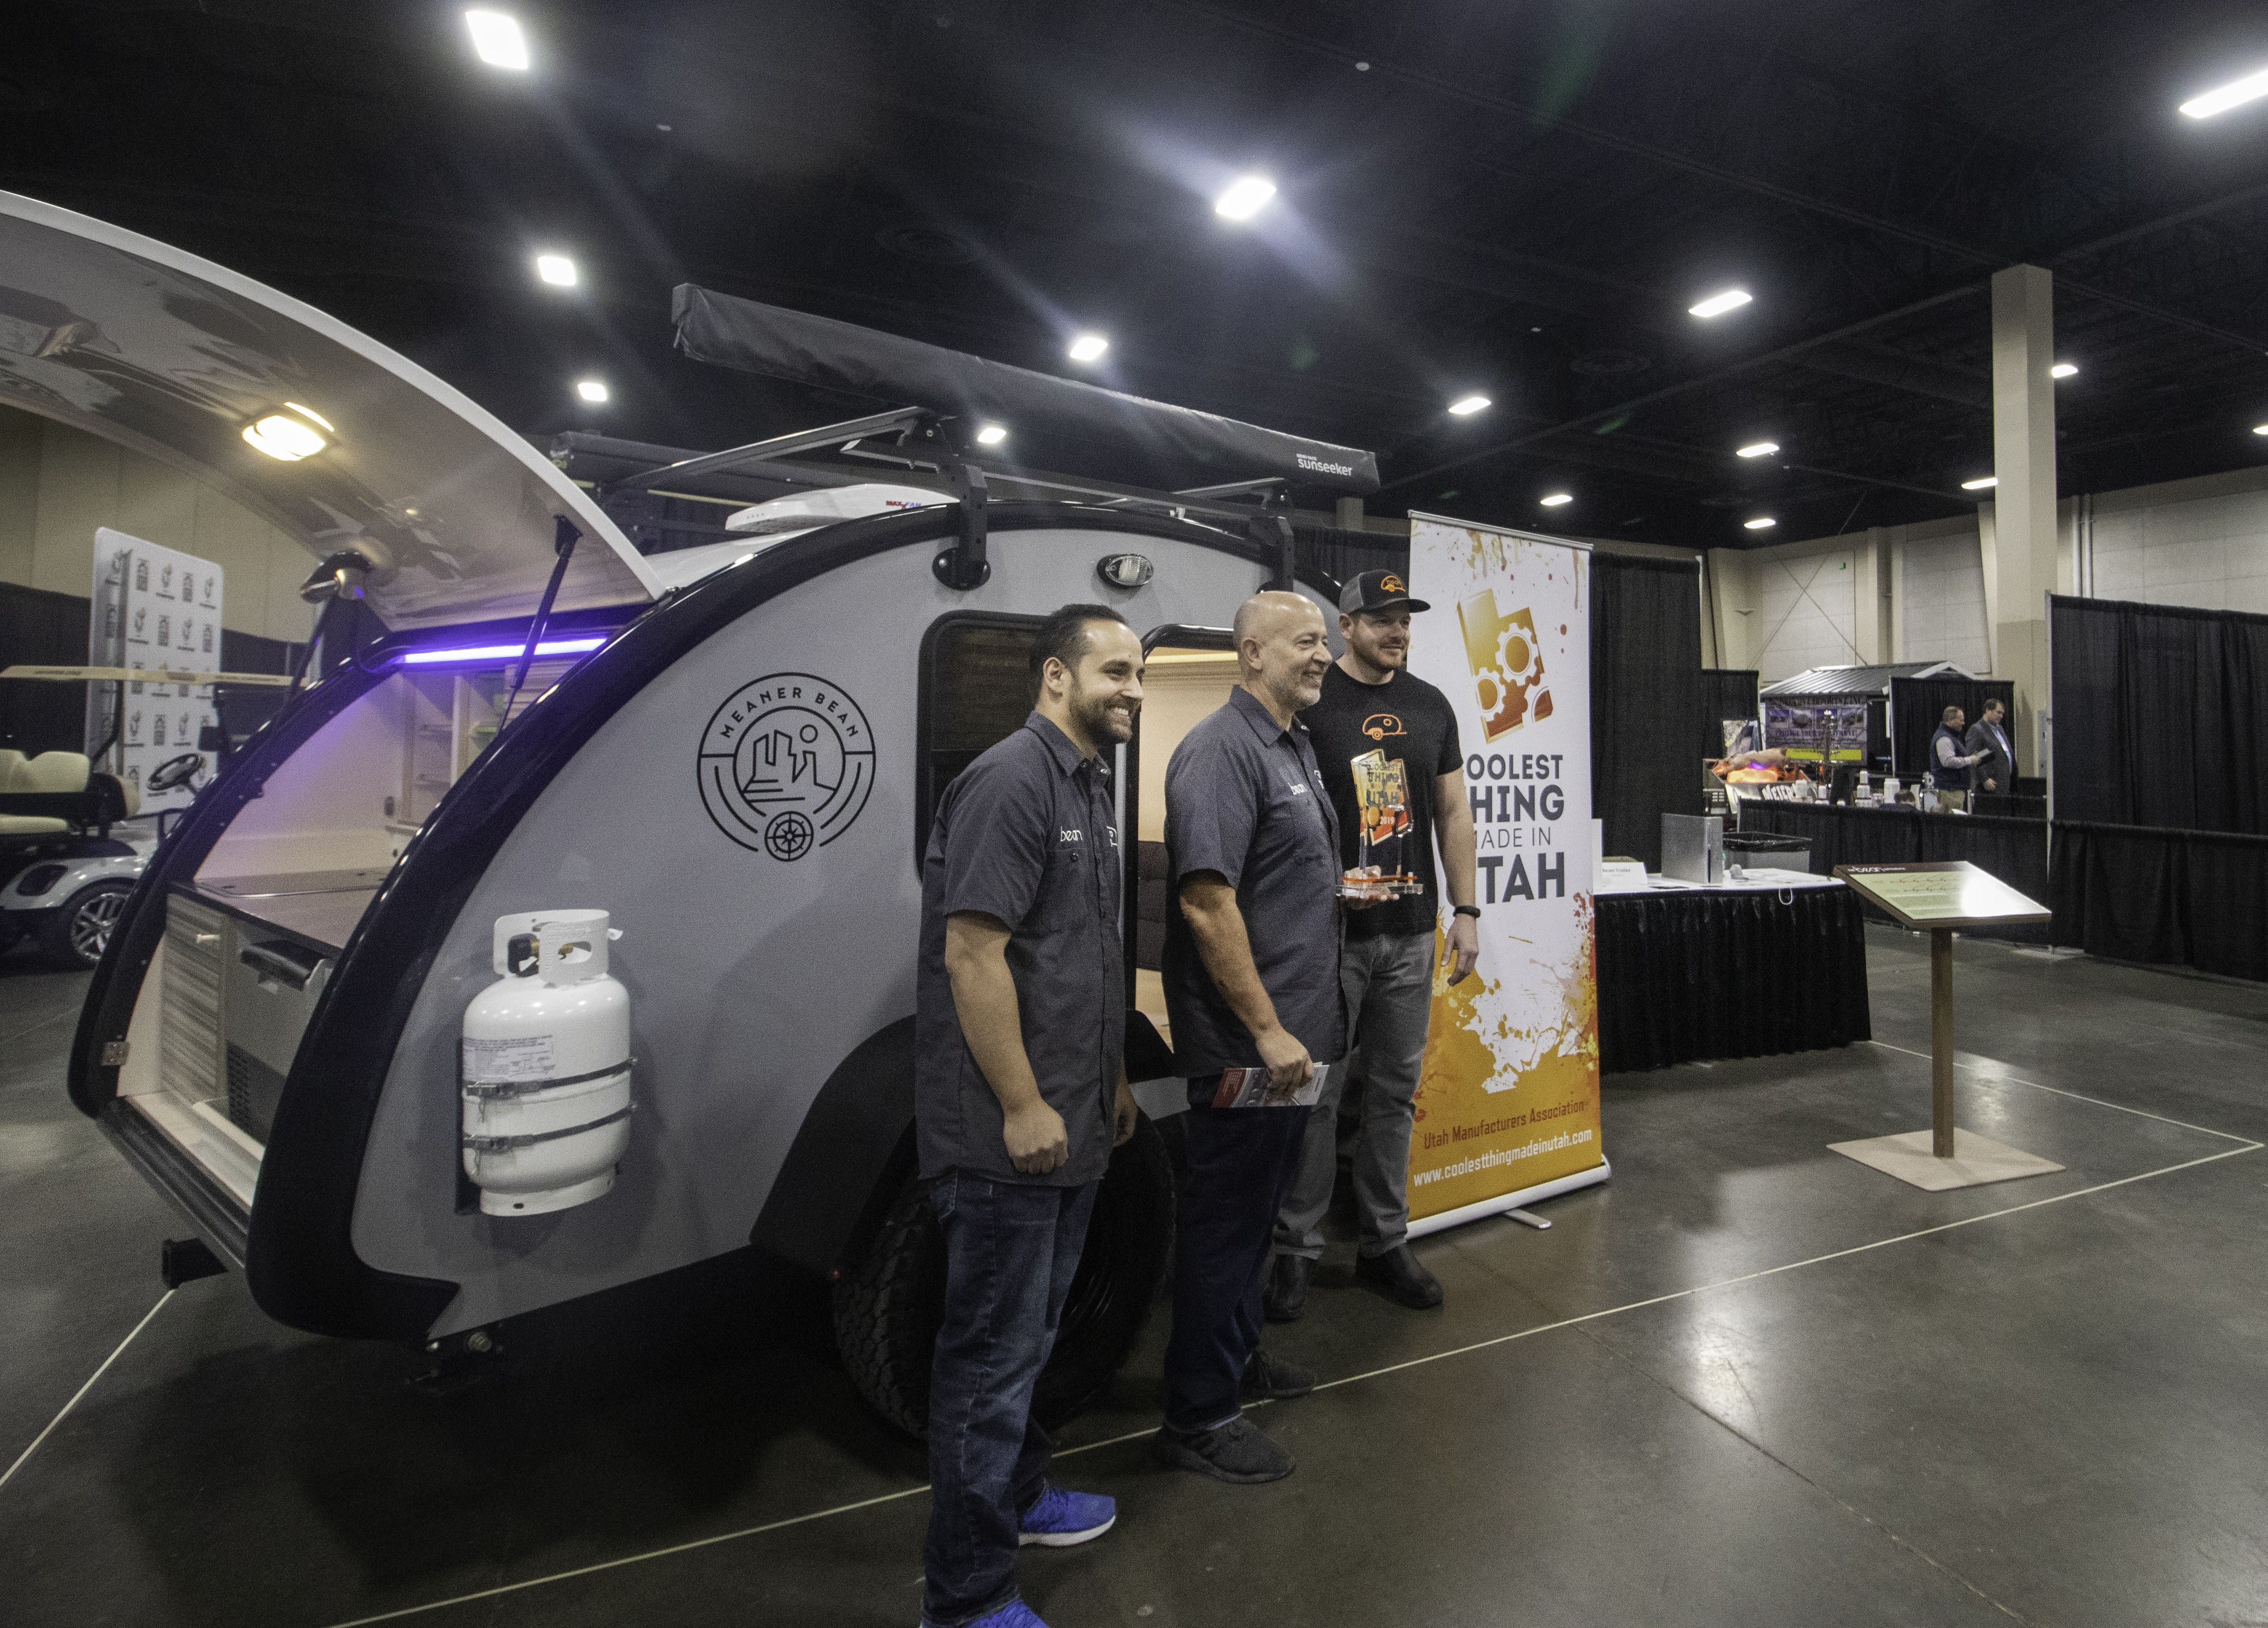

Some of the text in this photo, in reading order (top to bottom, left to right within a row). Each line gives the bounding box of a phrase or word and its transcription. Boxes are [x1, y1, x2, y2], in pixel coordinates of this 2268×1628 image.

[1298, 458, 1352, 476] sunseeker
[721, 687, 859, 738] MEANER BEAN
[1466, 753, 1563, 780] OOLEST
[1380, 816, 1394, 825] 2019
[1470, 784, 1564, 824] HING
[1060, 826, 1083, 842] bean
[1474, 827, 1551, 849] ADE IN
[1477, 852, 1565, 904] TAH
[1424, 1100, 1584, 1149] Utah Manufacturers Association
[1413, 1128, 1593, 1187] www.coolestthingmadeinutah.com
